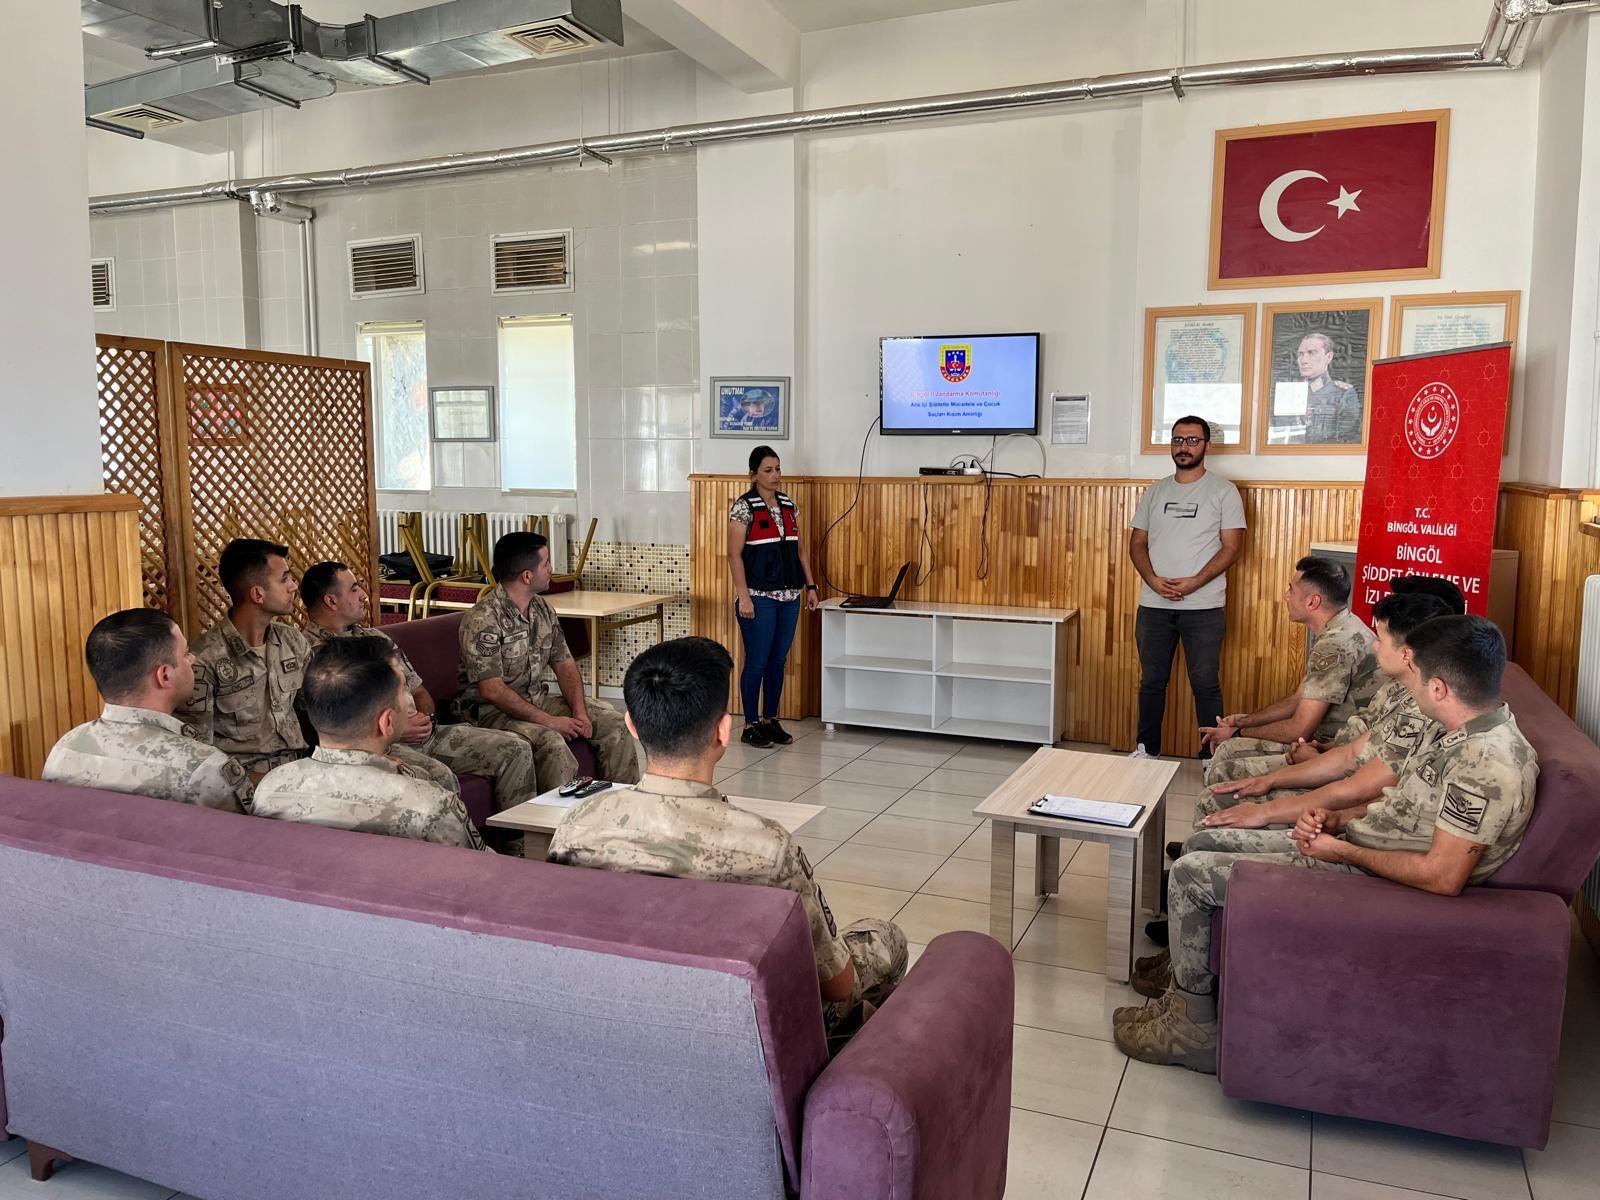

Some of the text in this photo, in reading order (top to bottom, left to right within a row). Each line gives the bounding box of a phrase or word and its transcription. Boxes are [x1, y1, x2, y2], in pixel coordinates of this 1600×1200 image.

[1415, 507, 1430, 518] T.C.
[1387, 521, 1457, 536] BİNGÖL VALİLİĞİ
[1396, 543, 1443, 564] BİNGÖL
[1462, 576, 1480, 594] VE
